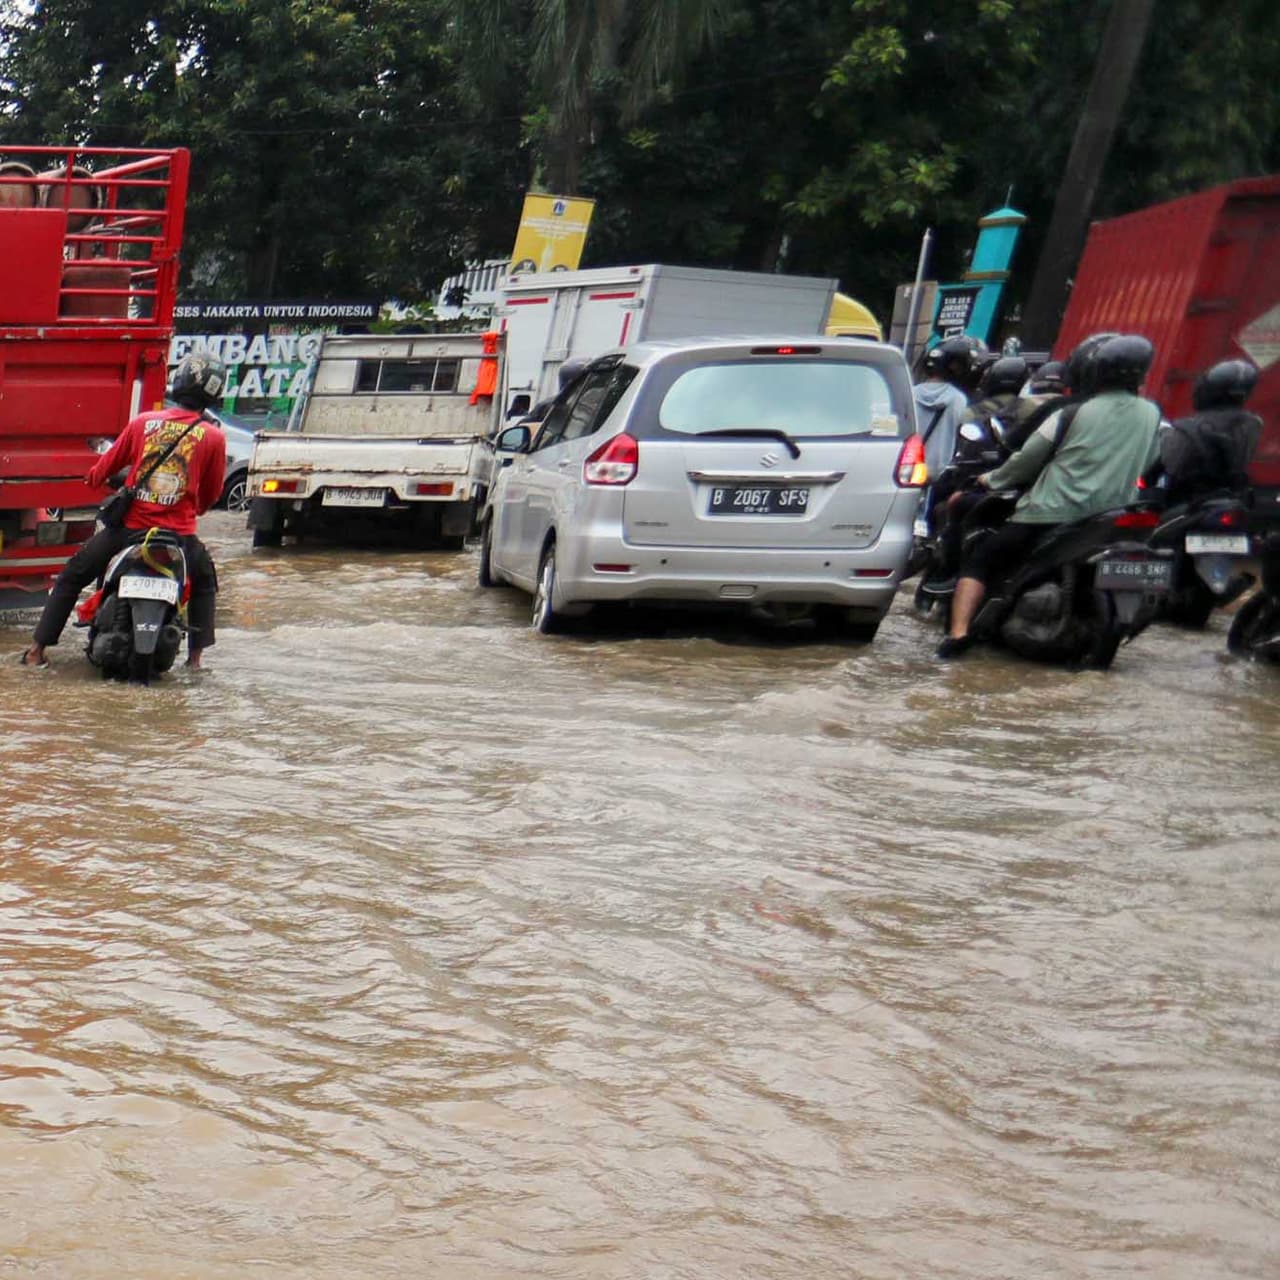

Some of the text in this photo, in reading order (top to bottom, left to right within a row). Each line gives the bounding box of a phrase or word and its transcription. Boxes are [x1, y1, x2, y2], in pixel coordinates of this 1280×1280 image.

[202, 306, 260, 318] JAKARTA
[263, 306, 305, 317] UNTUK
[308, 306, 373, 317] INDONESIA
[164, 420, 205, 442] EXPRSS
[712, 489, 809, 506] B 2067 SFS
